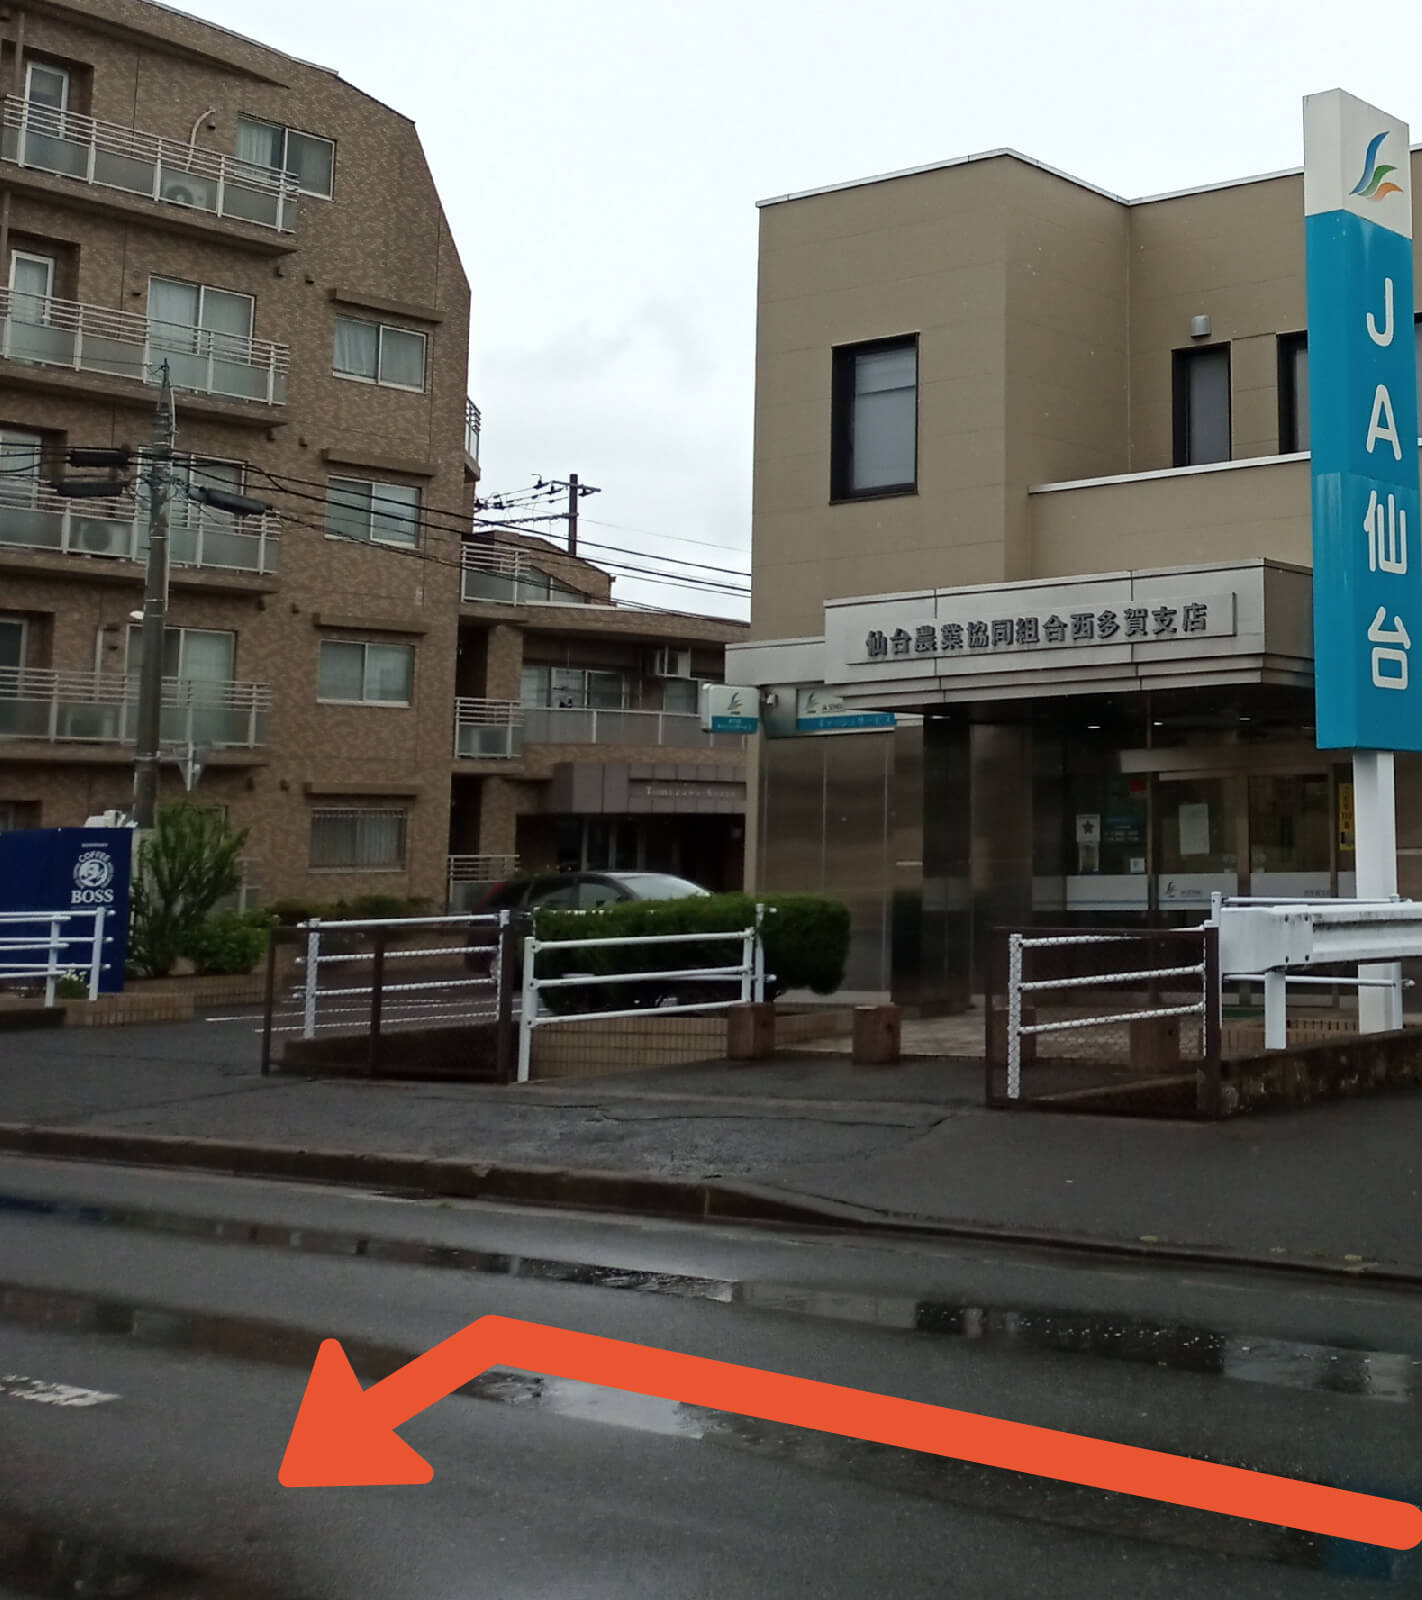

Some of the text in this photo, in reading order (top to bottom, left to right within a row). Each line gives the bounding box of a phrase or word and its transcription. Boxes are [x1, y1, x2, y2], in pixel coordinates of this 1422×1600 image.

[1364, 277, 1411, 690] JA仙台
[865, 602, 1207, 657] 仙台農業協同組合西多賀支店
[71, 889, 114, 904] BOSS
